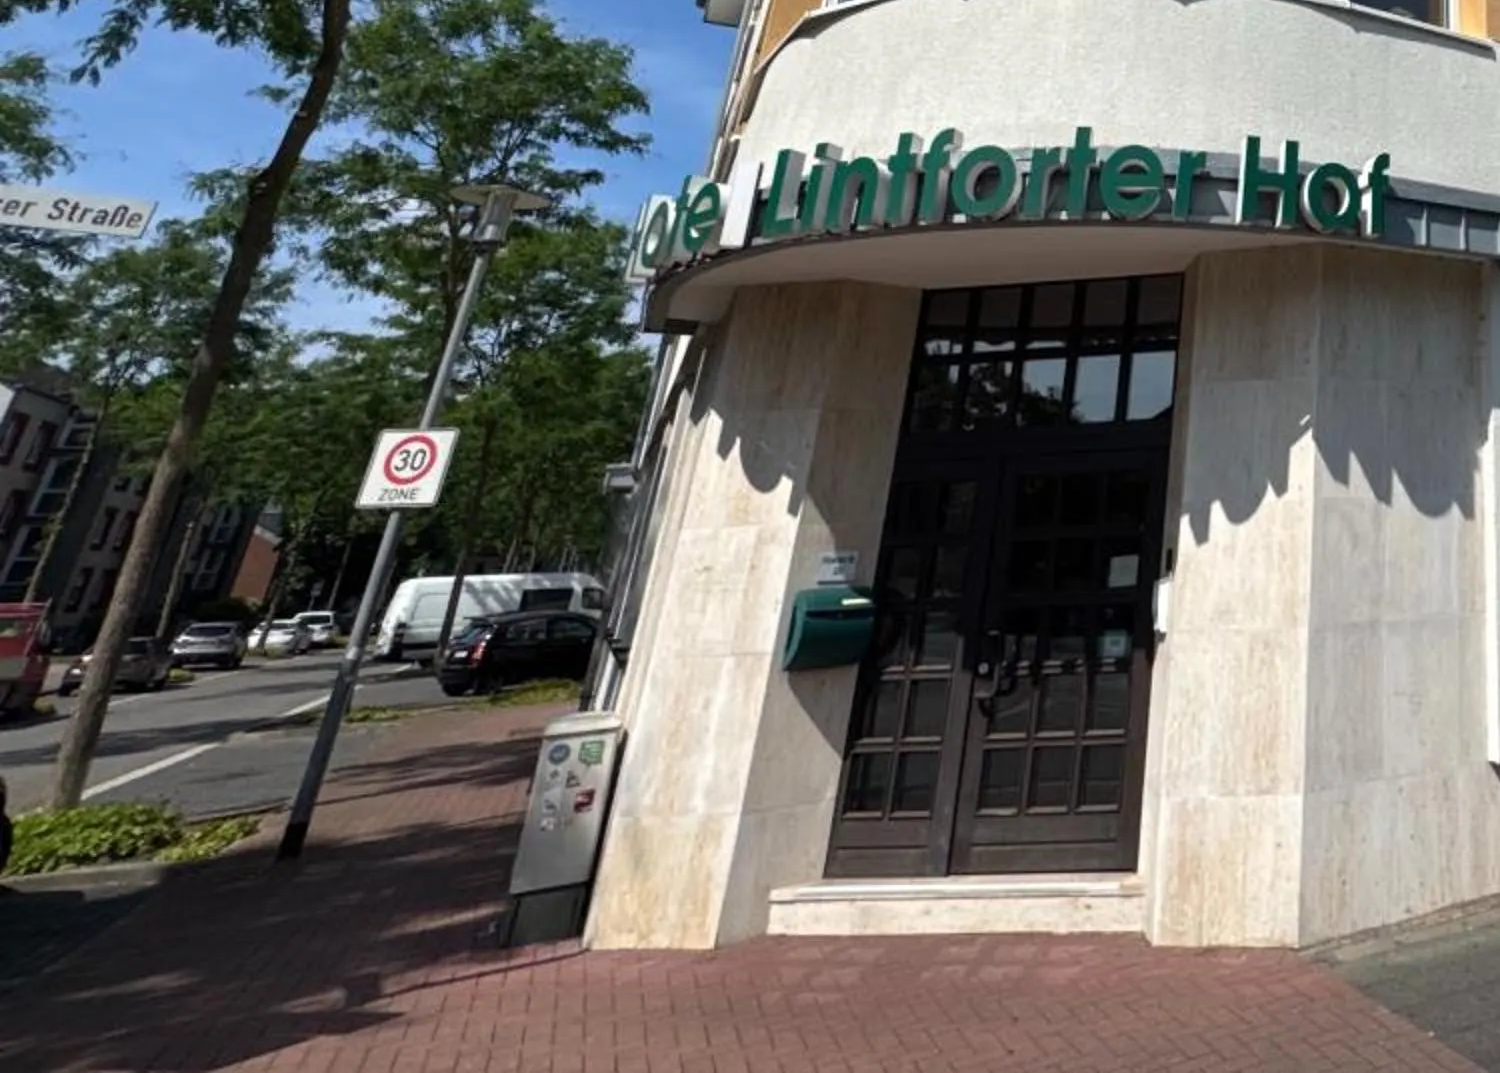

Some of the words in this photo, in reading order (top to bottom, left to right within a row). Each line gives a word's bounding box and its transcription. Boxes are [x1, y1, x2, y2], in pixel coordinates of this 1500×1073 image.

[762, 126, 1207, 238] Lintforter
[1237, 134, 1391, 238] Hof
[47, 196, 143, 228] Straße
[393, 448, 427, 472] 30
[377, 488, 420, 502] ZONE
